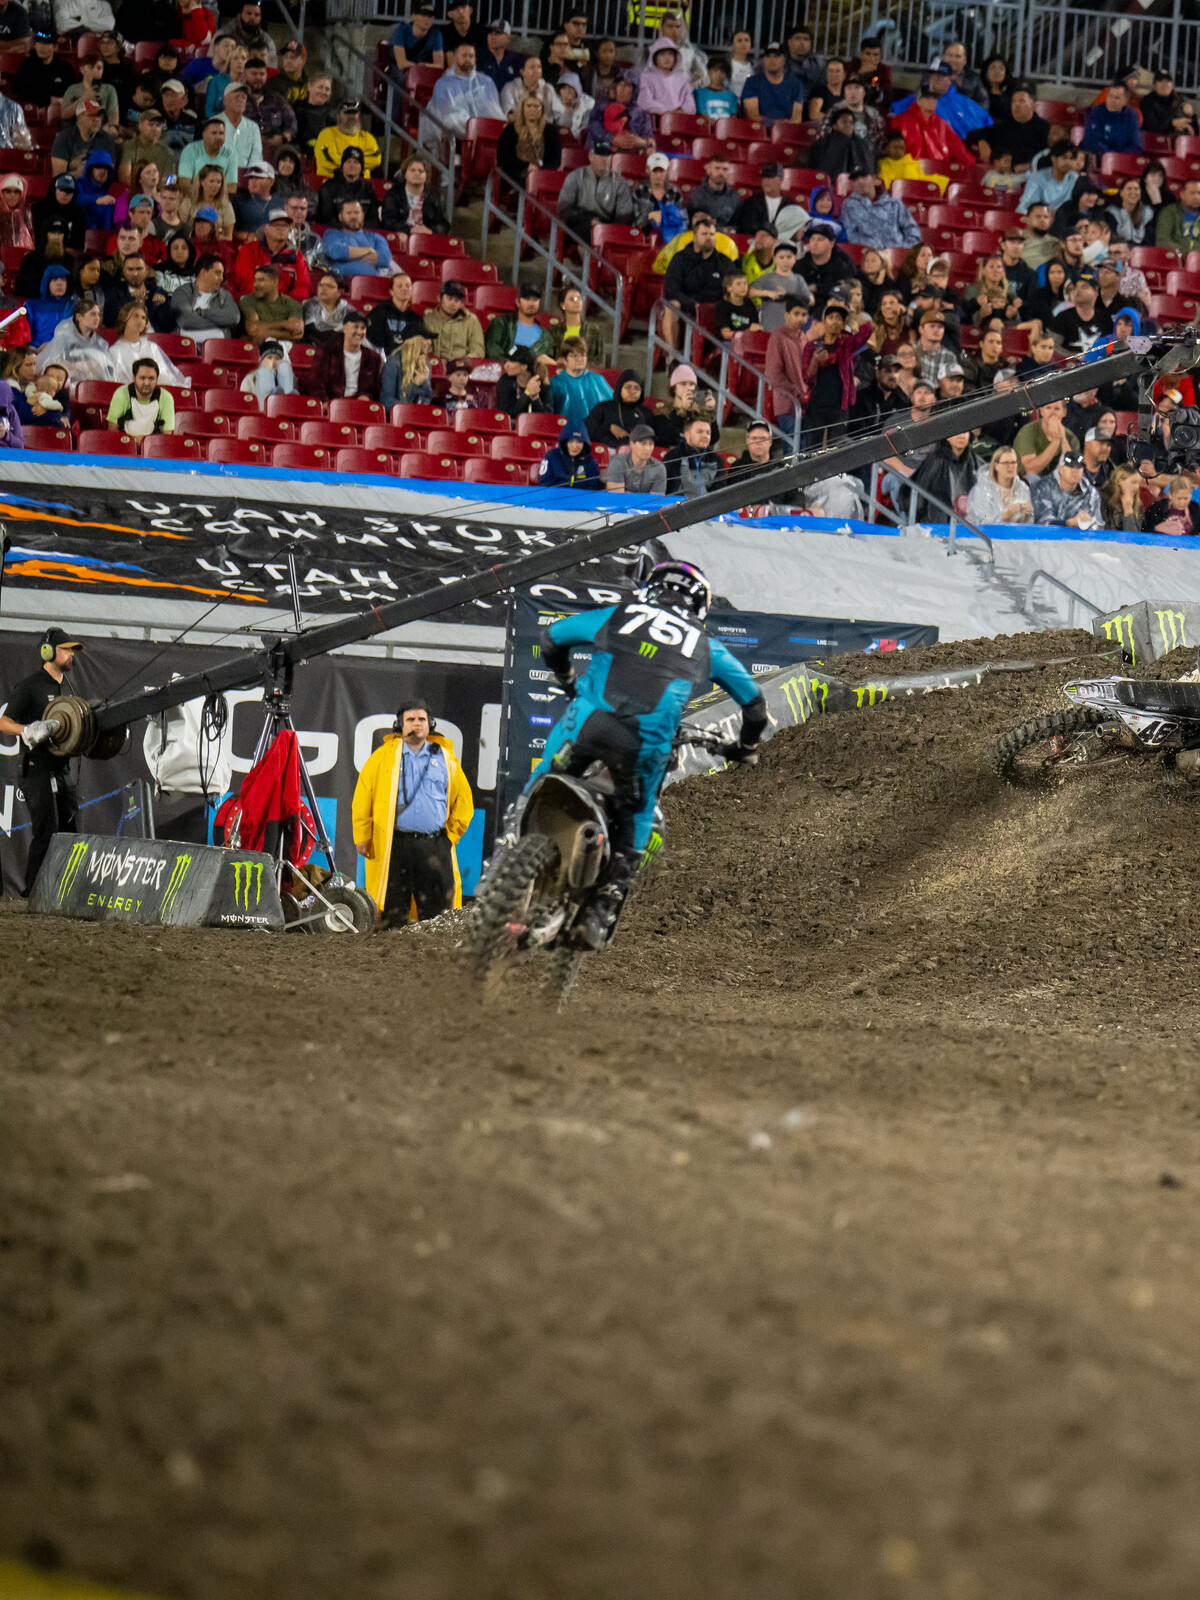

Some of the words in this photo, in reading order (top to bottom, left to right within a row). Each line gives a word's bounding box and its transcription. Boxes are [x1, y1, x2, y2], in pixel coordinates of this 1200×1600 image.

[126, 499, 326, 526] UTAH
[196, 557, 398, 589] UTAH
[618, 603, 701, 659] 751
[87, 893, 142, 913] ENERGY
